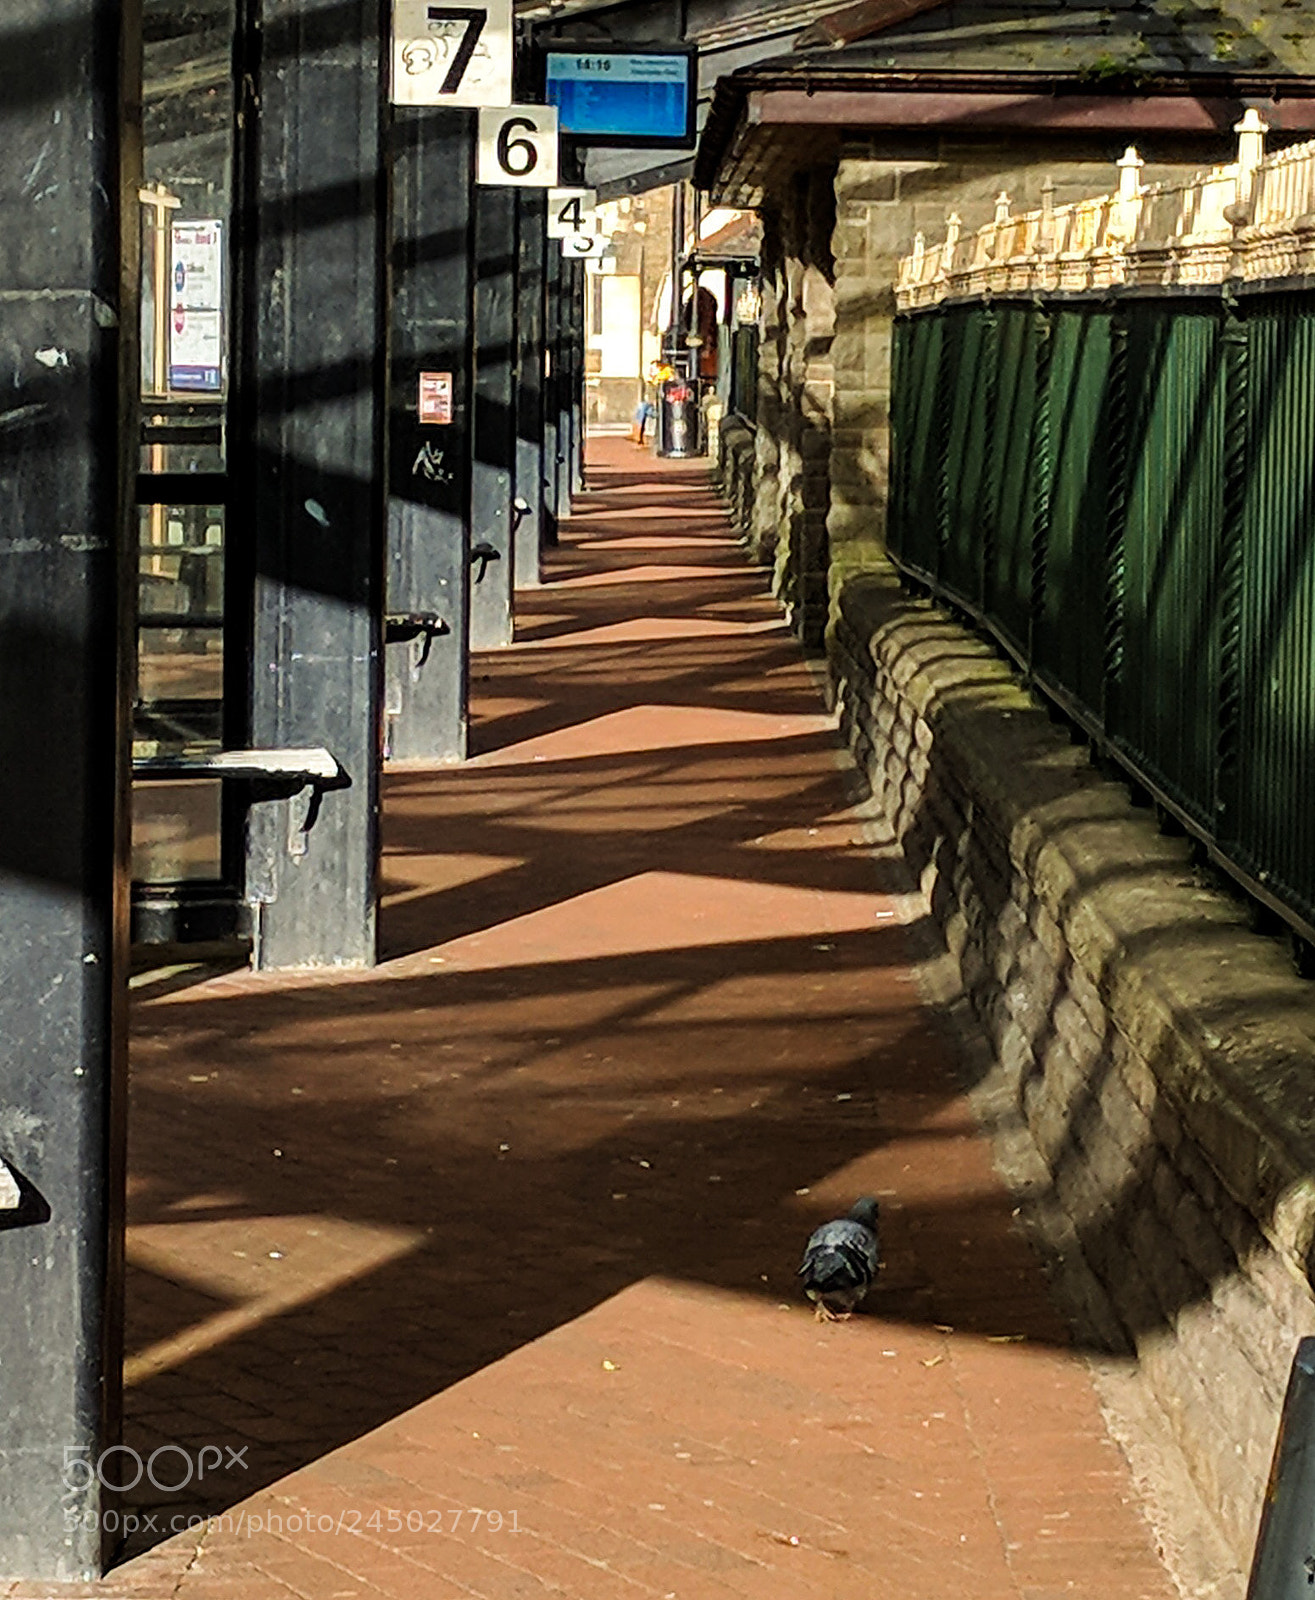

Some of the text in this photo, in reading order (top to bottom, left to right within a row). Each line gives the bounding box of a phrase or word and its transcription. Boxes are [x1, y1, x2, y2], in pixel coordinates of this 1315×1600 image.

[427, 7, 487, 94] 7
[497, 117, 538, 176] 6
[558, 197, 586, 232] 4
